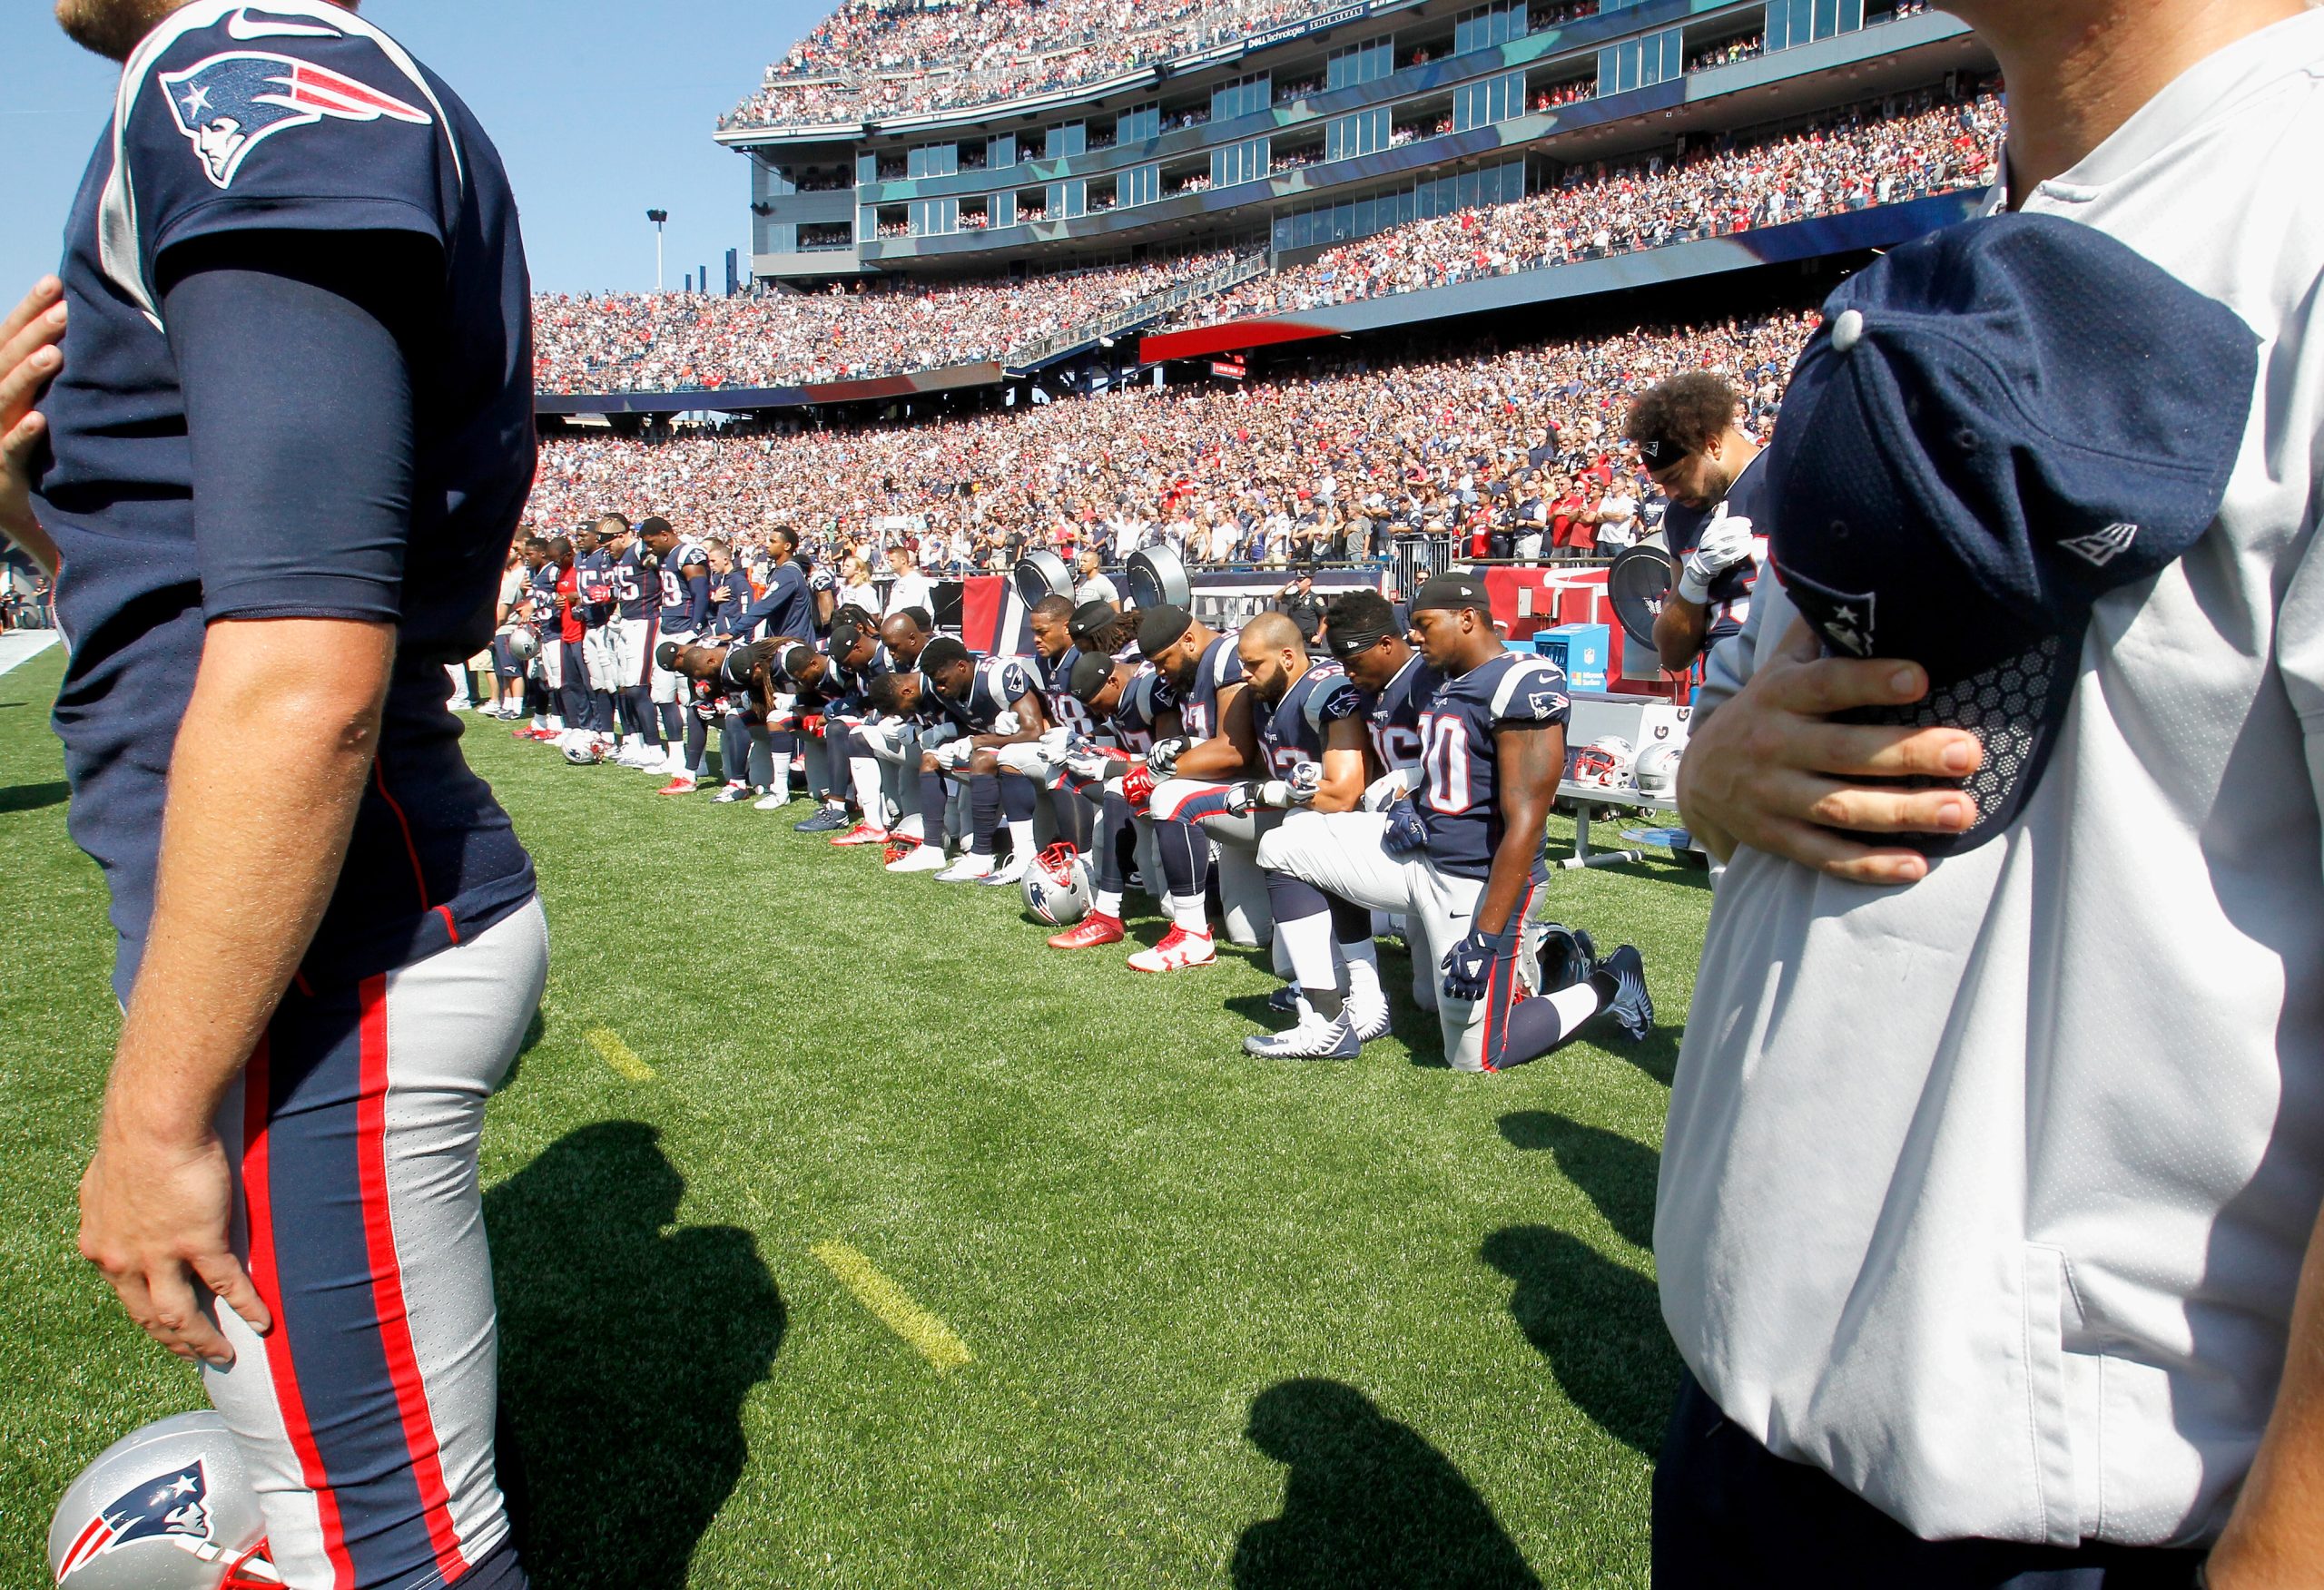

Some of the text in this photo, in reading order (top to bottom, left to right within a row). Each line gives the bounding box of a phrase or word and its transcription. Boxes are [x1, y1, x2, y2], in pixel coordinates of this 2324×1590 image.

[1310, 7, 1364, 29] SUITE LEVELS
[1266, 25, 1305, 43] Technologies
[1417, 712, 1472, 815] 70
